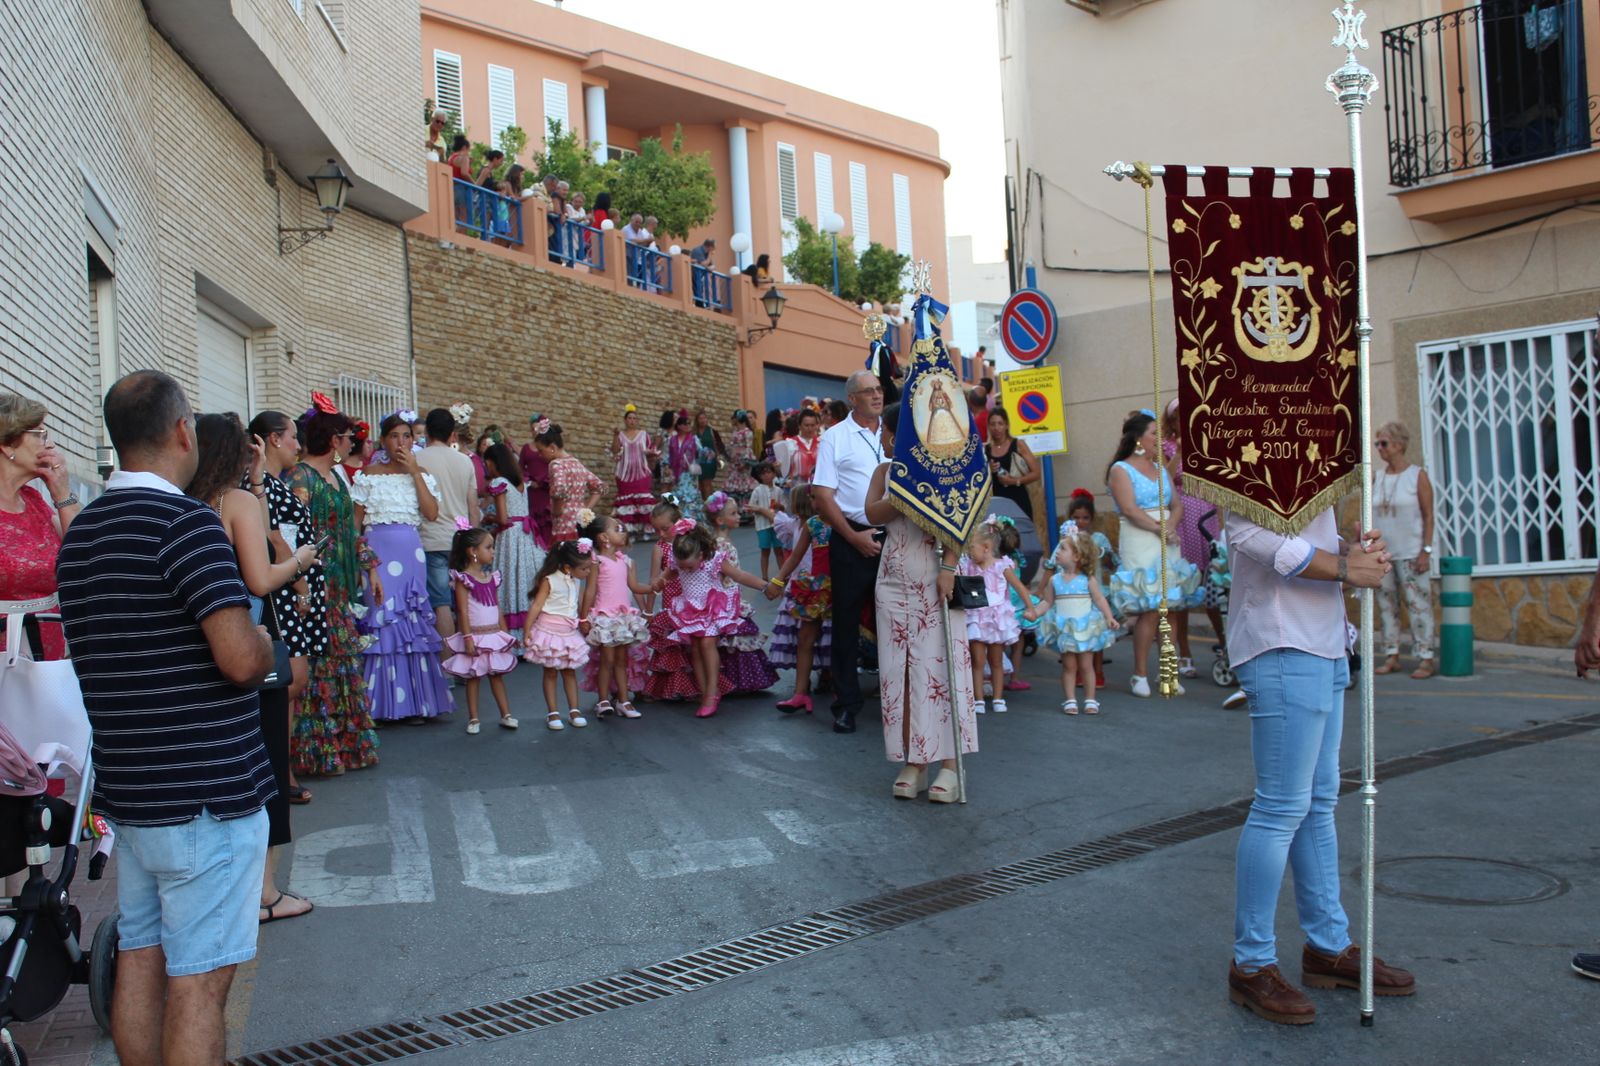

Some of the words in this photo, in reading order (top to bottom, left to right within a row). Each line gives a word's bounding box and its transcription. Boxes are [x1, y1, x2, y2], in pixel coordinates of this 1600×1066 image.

[1009, 383, 1053, 393] EXCEPCIONAL
[1241, 374, 1314, 393] Hermandad
[1212, 397, 1270, 416] Nuestra
[1203, 420, 1253, 449] Virgen
[1261, 417, 1287, 437] Del
[1262, 441, 1300, 460] 2001
[922, 460, 933, 471] DE
[961, 453, 973, 467] DEL
